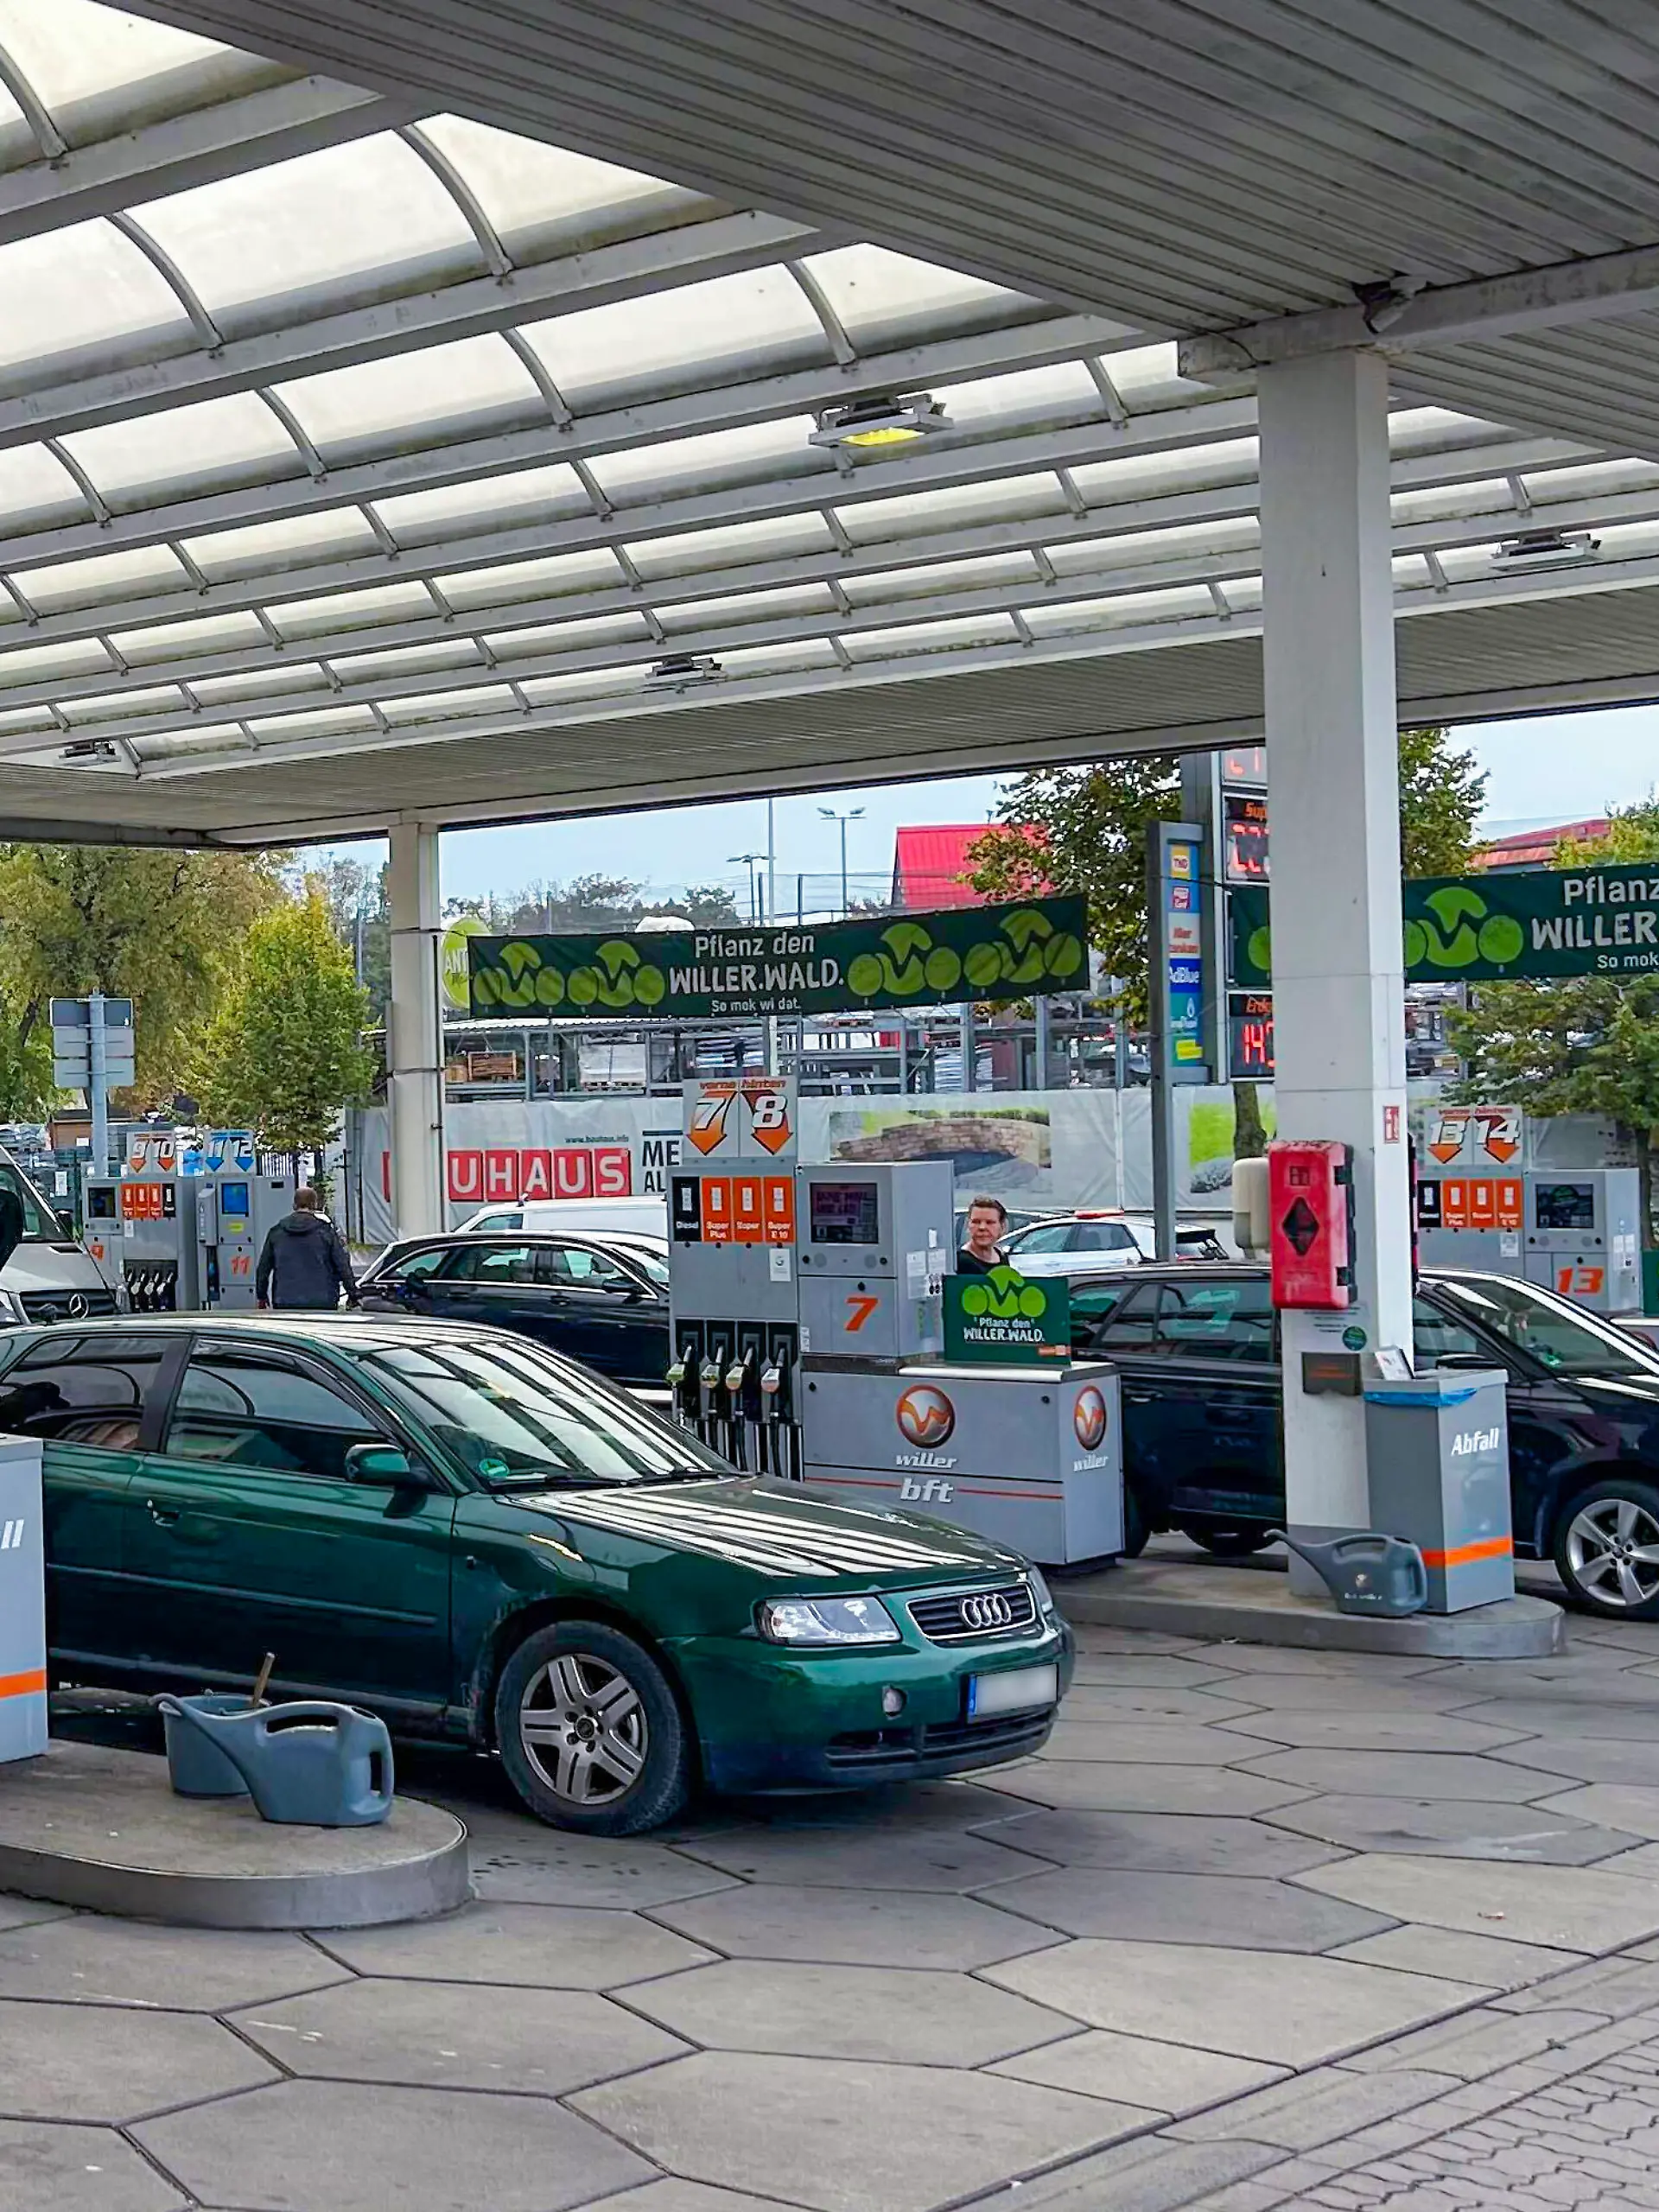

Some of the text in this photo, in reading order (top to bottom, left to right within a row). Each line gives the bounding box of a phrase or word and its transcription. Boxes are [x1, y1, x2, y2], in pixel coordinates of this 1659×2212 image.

[1245, 802, 1268, 820] Sup
[1564, 875, 1659, 906] Pflanz
[695, 931, 815, 958] Pflanz den
[1597, 951, 1659, 969] So mok
[669, 958, 844, 995] WILLER.WALD.
[711, 1000, 727, 1013] So
[730, 997, 756, 1012] mok
[760, 996, 774, 1011] wi
[694, 1095, 788, 1130] 7 8
[1428, 1118, 1521, 1146] 13 14
[131, 1139, 175, 1159] 9 10
[207, 1139, 253, 1158] 11 12
[450, 1153, 626, 1195] UHAUS
[231, 1255, 251, 1275] 11
[1557, 1264, 1605, 1294] 13
[845, 1297, 879, 1332] 7
[1451, 1427, 1500, 1457] Abfall
[895, 1452, 957, 1470] willer
[1072, 1453, 1109, 1472] willer
[899, 1477, 955, 1503] bft
